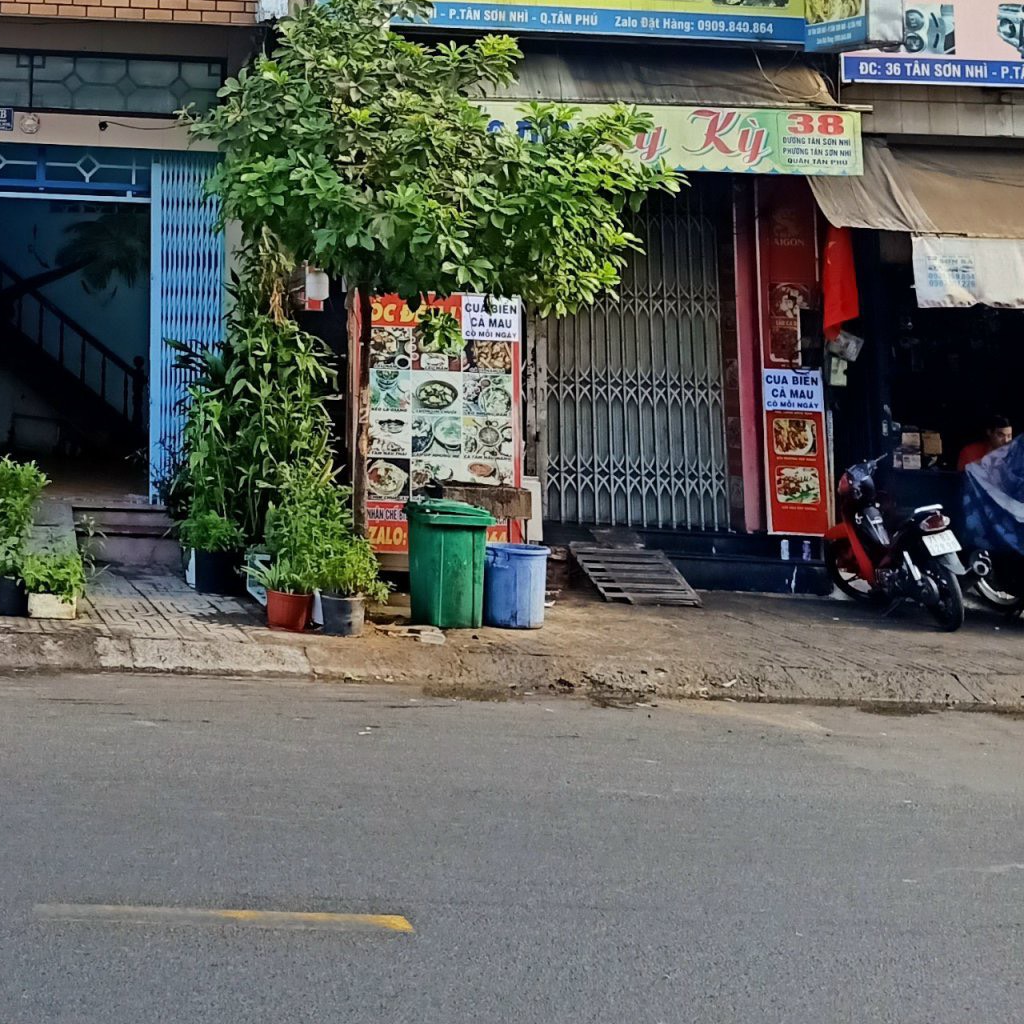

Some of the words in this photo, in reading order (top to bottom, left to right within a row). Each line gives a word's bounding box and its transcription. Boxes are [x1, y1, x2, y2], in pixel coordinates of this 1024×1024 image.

[448, 8, 480, 21] P.TÂN
[484, 10, 505, 22] SƠN
[575, 12, 597, 25] PHÚ
[614, 15, 637, 28] Zalo
[663, 17, 694, 32] Hàng:
[885, 63, 901, 76] 36
[904, 60, 930, 76] TÂN
[934, 62, 960, 78] SƠN
[965, 63, 987, 78] NHÌ
[787, 113, 845, 136] 38
[489, 317, 512, 329] MAU
[765, 375, 788, 385] CUA
[790, 388, 814, 400] MAU
